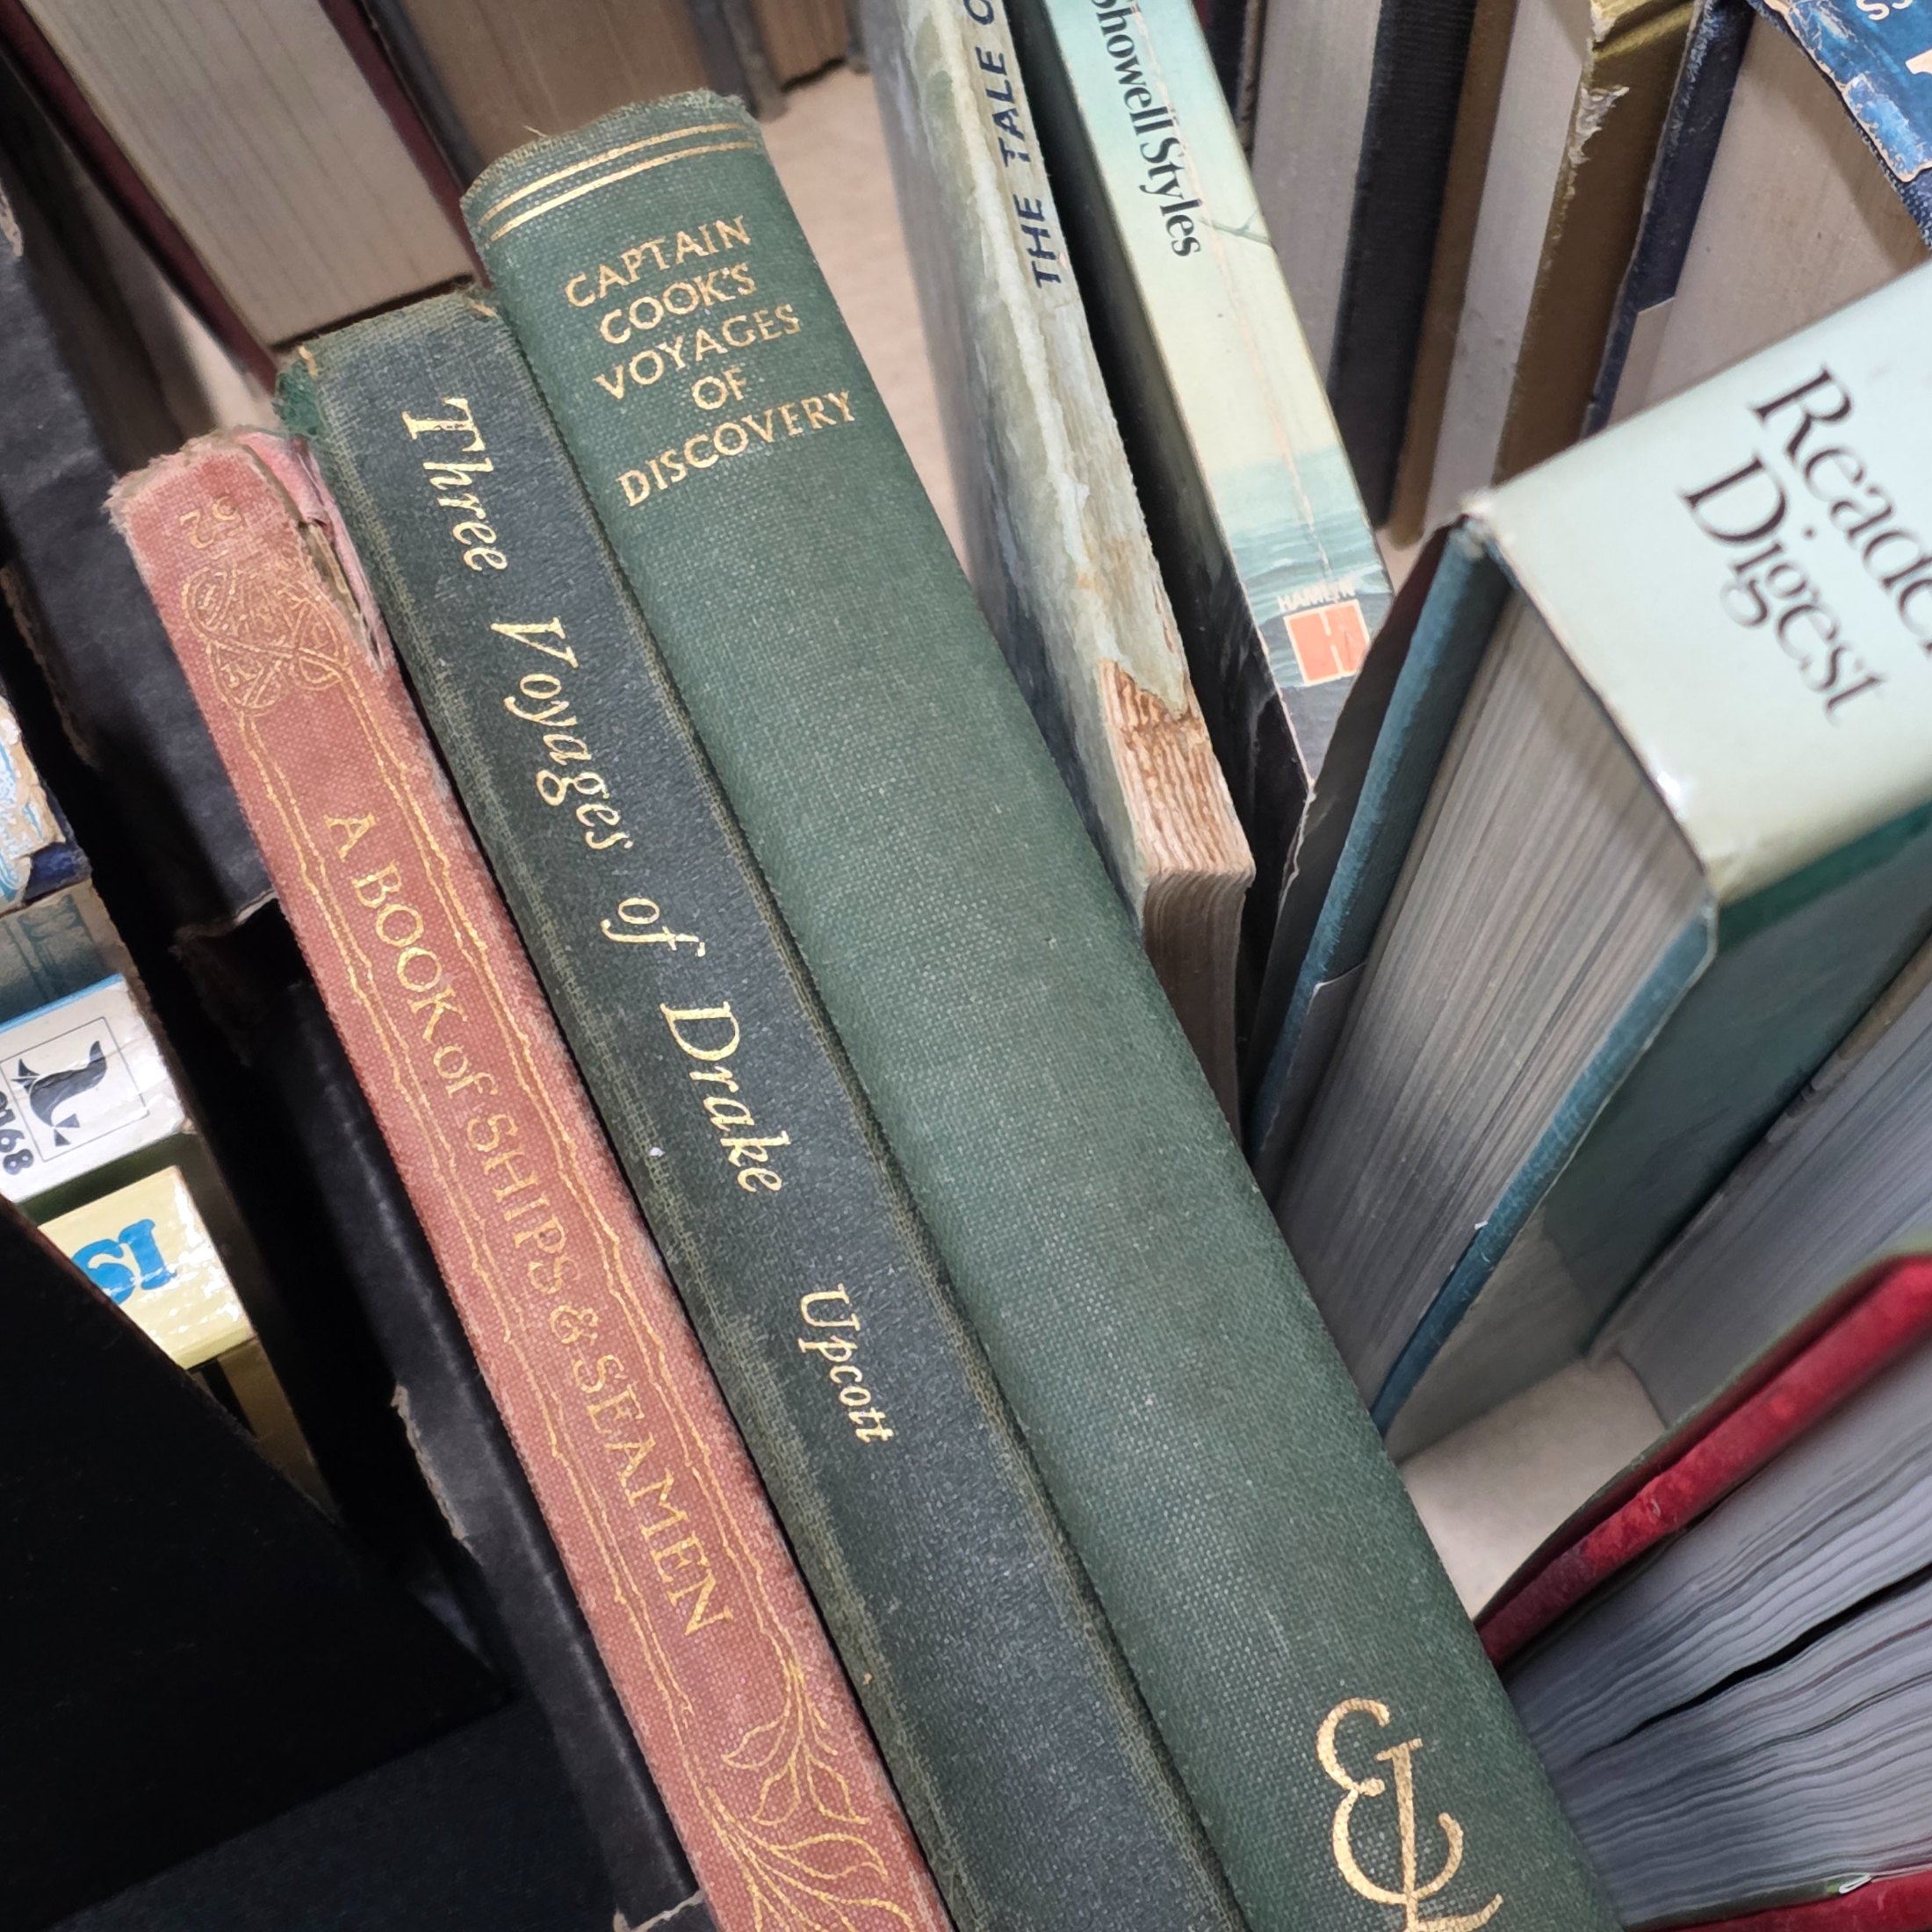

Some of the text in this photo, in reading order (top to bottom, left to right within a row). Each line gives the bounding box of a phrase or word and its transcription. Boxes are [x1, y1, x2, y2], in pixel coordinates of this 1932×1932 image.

[976, 47, 1031, 167] TALE
[1014, 194, 1061, 289] THE
[1139, 137, 1203, 257] Styles
[565, 214, 751, 307] CAPTAIN
[600, 263, 757, 344] COOK'S
[594, 304, 801, 400] VOYAGES
[691, 366, 747, 410] OF
[616, 390, 856, 507] DISCOVERY
[1678, 451, 1886, 730] Digest
[401, 397, 791, 1193] Three Voyages of Drake
[323, 811, 734, 1637] A BOOK of SHIPS & SEAMEN
[797, 1283, 894, 1444] Upcott
